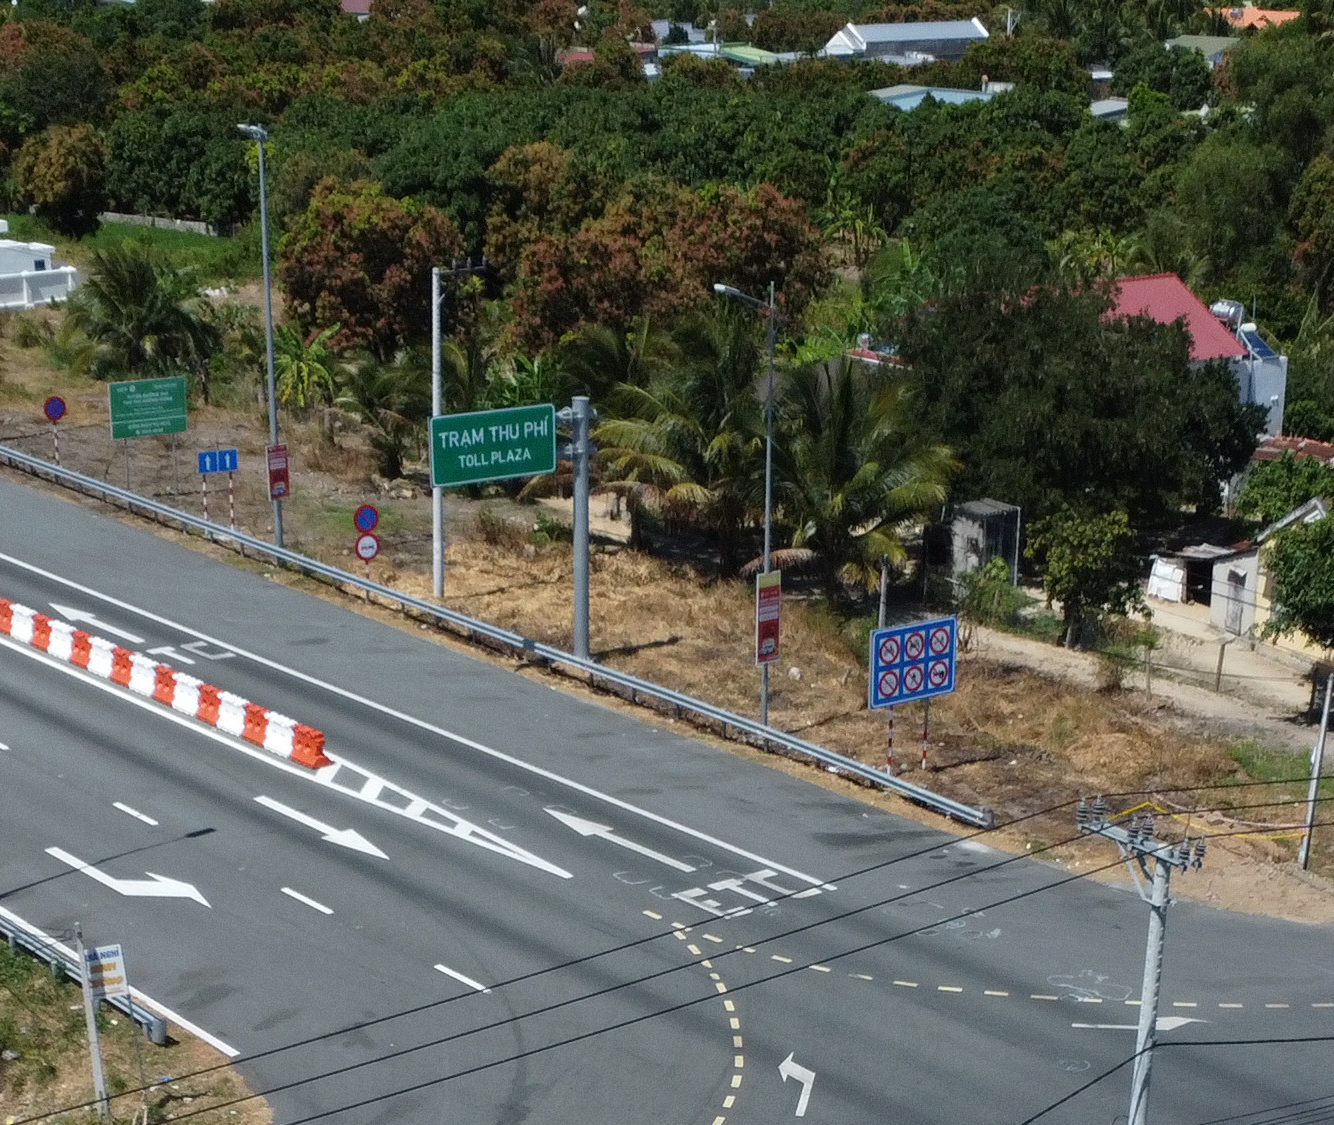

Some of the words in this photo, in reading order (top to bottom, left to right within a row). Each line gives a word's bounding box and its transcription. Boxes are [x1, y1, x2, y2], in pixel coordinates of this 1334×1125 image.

[438, 427, 484, 449] TRẠM
[488, 422, 520, 443] THU
[524, 415, 549, 439] PHÍ
[458, 453, 489, 469] TOLL
[491, 447, 532, 465] PLAZA
[671, 868, 823, 920] ETC
